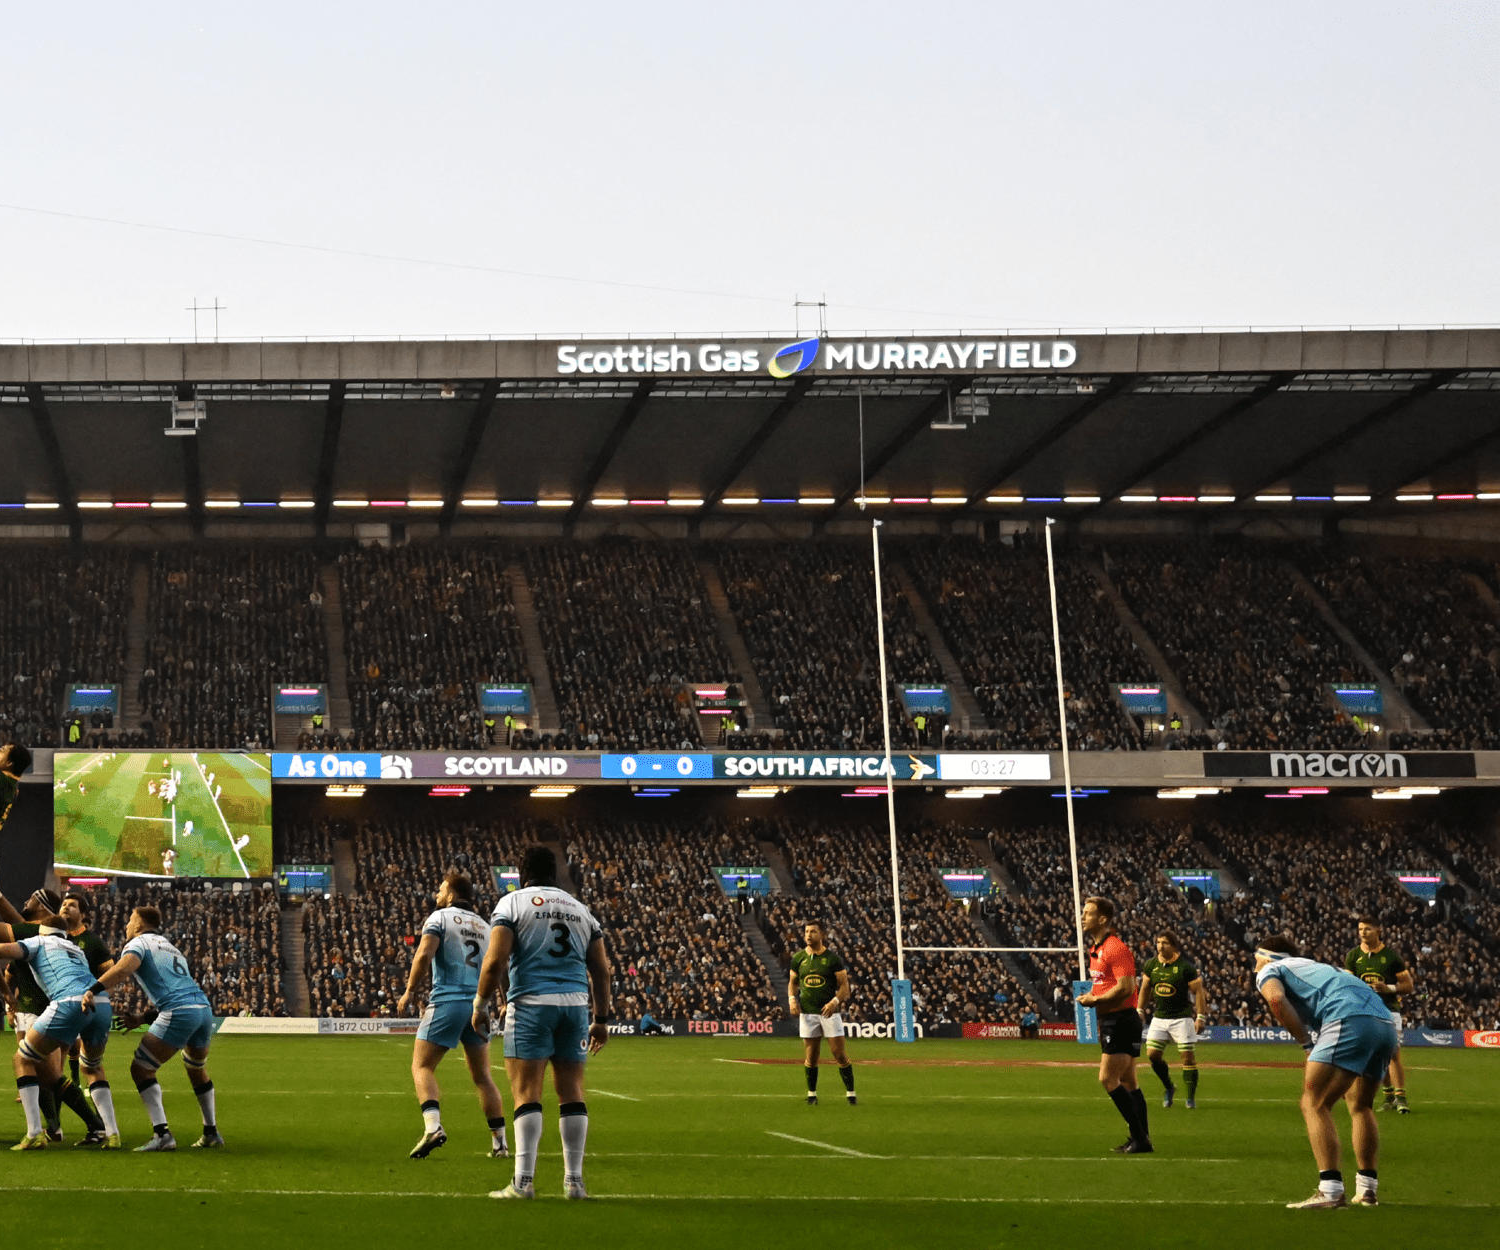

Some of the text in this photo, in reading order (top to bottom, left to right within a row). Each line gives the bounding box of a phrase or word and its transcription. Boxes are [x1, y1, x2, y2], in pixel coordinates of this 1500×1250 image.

[557, 342, 1077, 374] Scottish Gas MURRAYFIELD
[288, 754, 367, 777] As One
[444, 756, 568, 776] SCOTLAND
[621, 756, 637, 775] 0
[677, 756, 693, 775] 0
[724, 757, 897, 776] SOUTH AFRICA
[971, 760, 1016, 775] 03:27
[1269, 752, 1408, 778] macron
[535, 911, 581, 924] Z.FAGERSON
[460, 929, 485, 940] ASHMAN
[547, 922, 571, 959] 3
[464, 939, 480, 968] 2
[173, 956, 187, 976] 6
[333, 1022, 357, 1032] 1872
[360, 1022, 383, 1032] CUP
[607, 1022, 635, 1034] rries
[688, 1021, 719, 1033] FEED
[722, 1021, 744, 1033] THE
[747, 1021, 773, 1033] DOG
[842, 1022, 924, 1038] macrn
[900, 1011, 909, 1038] Scottish
[1038, 1028, 1077, 1036] THE SPIRIT
